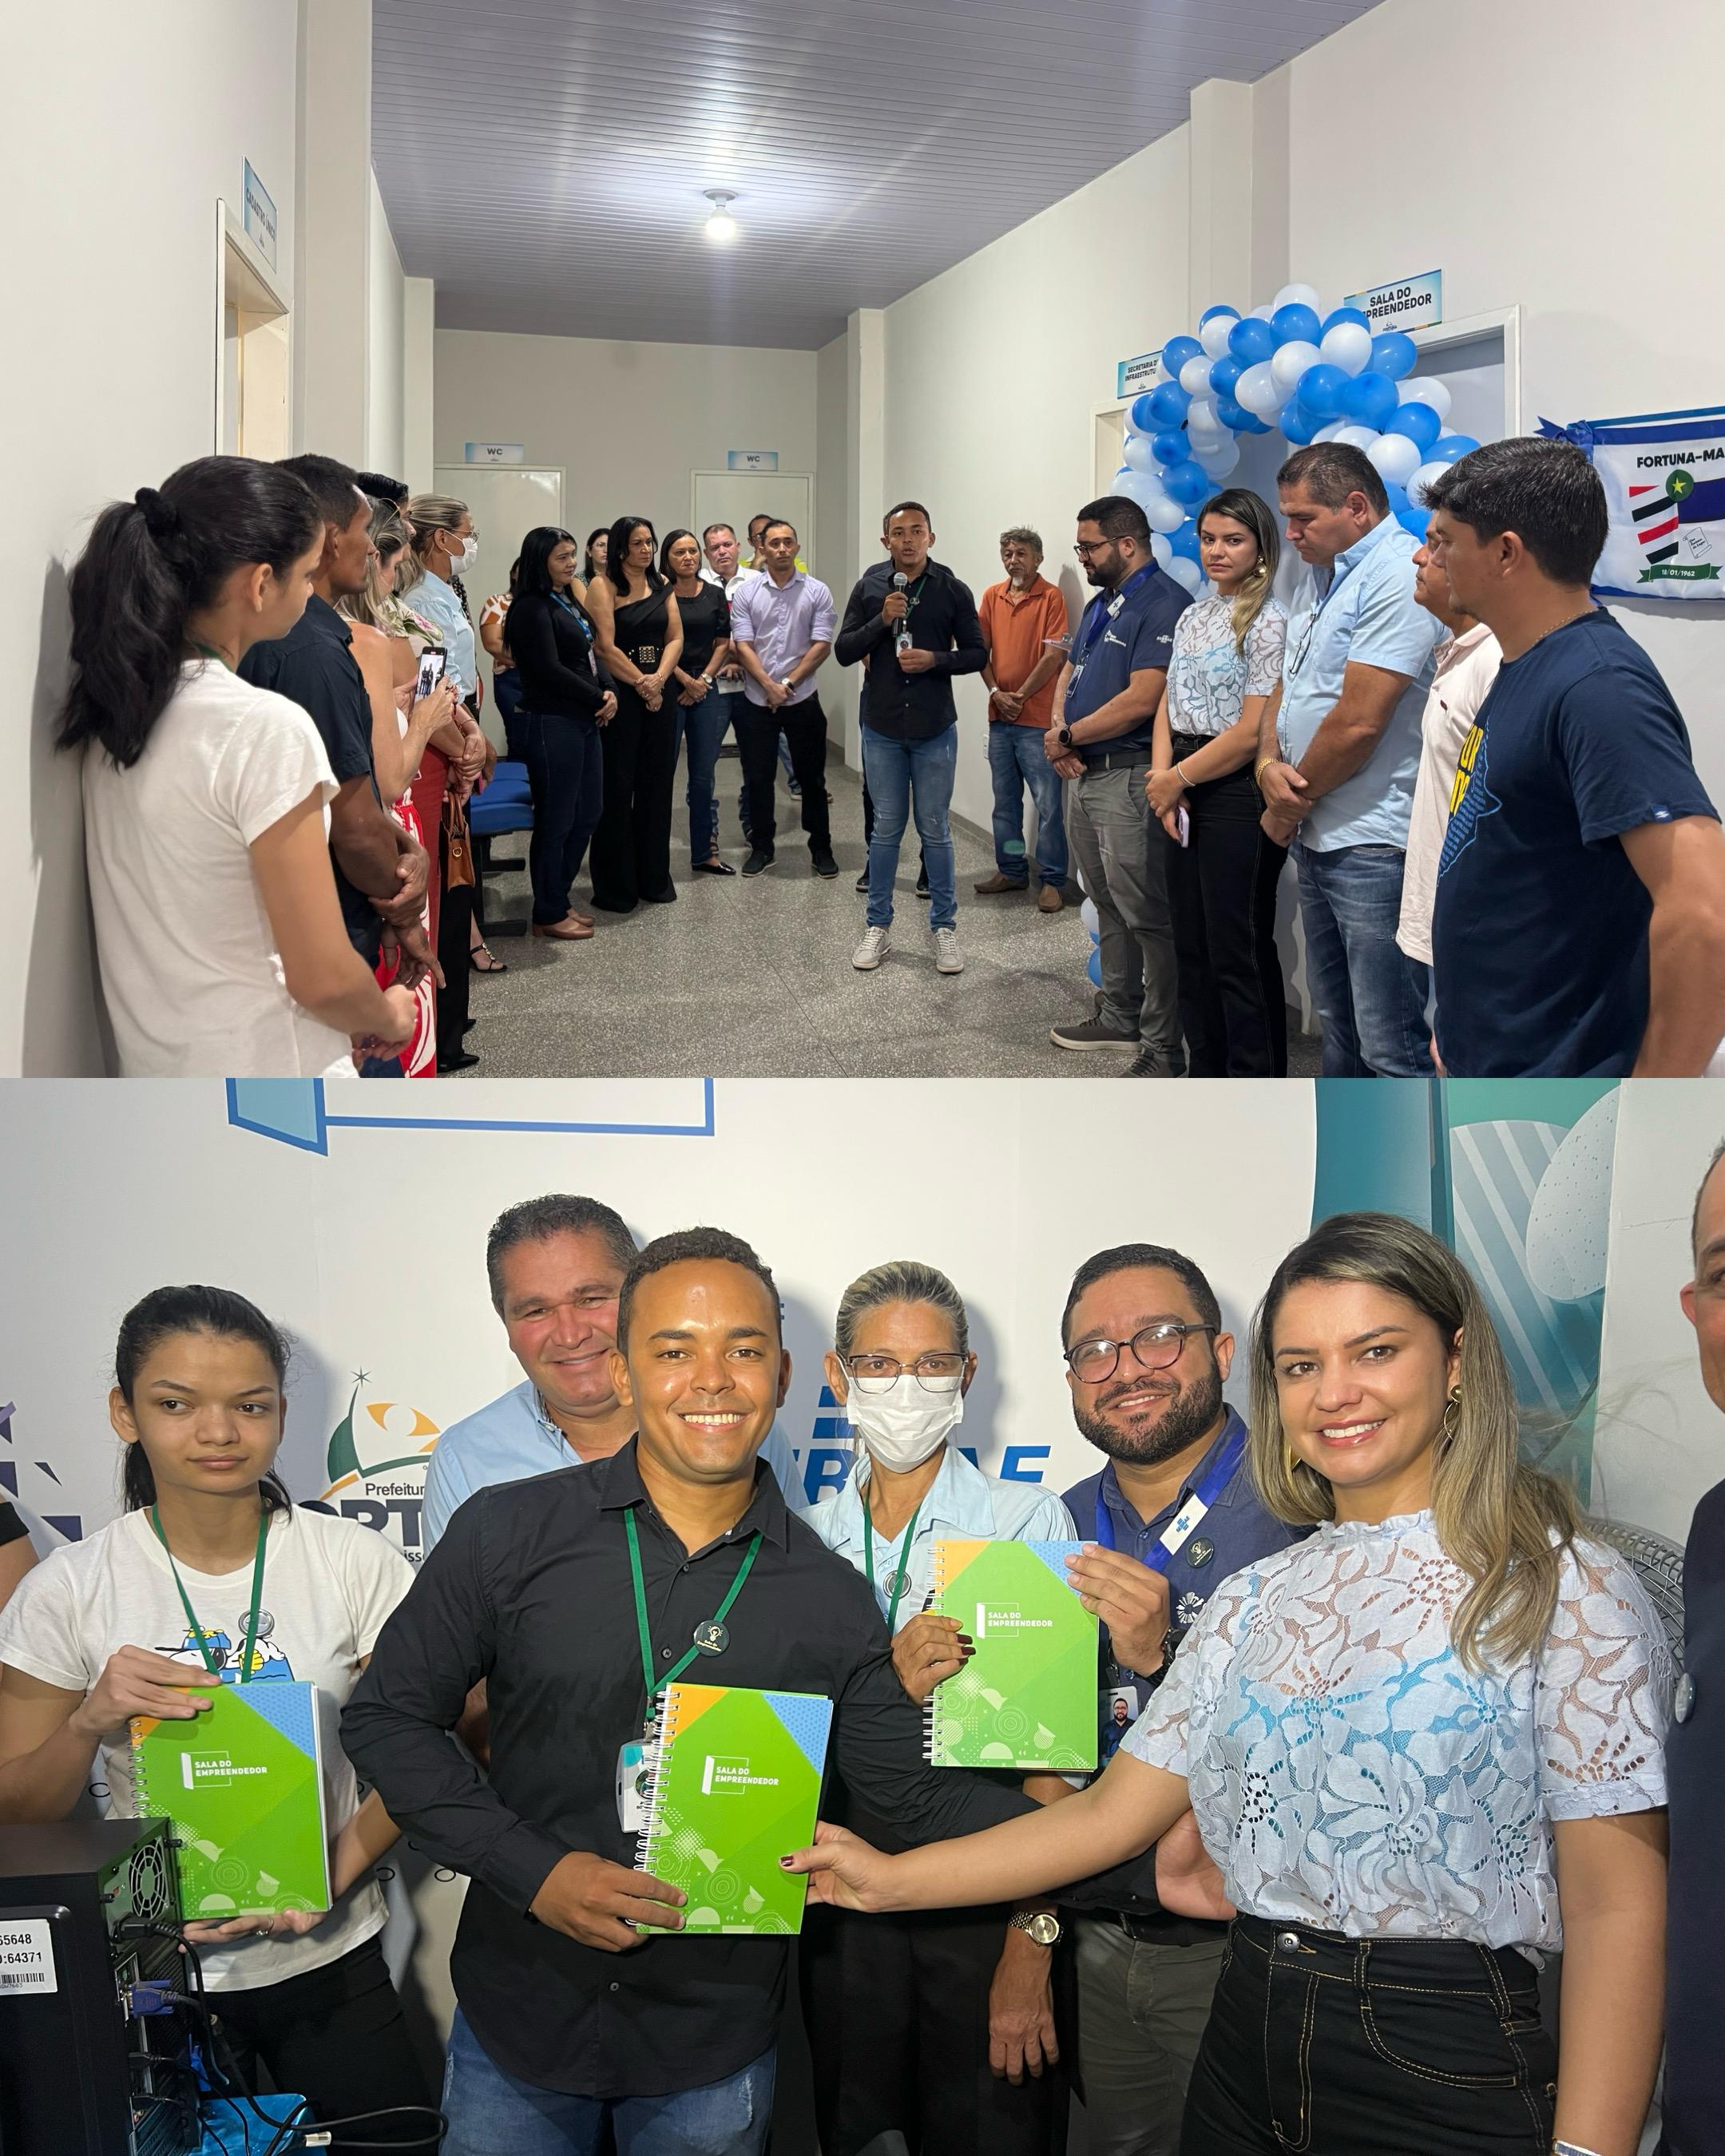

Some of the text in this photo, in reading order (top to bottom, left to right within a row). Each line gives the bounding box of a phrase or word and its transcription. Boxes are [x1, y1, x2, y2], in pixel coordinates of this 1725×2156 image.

[246, 187, 265, 227] CADASTRO
[1370, 287, 1411, 307] SALA DO
[1128, 361, 1152, 373] SECRETARIA
[196, 1766, 268, 1777] EMPREENDEDOR
[715, 1775, 779, 1785] EMPREENDEDOR
